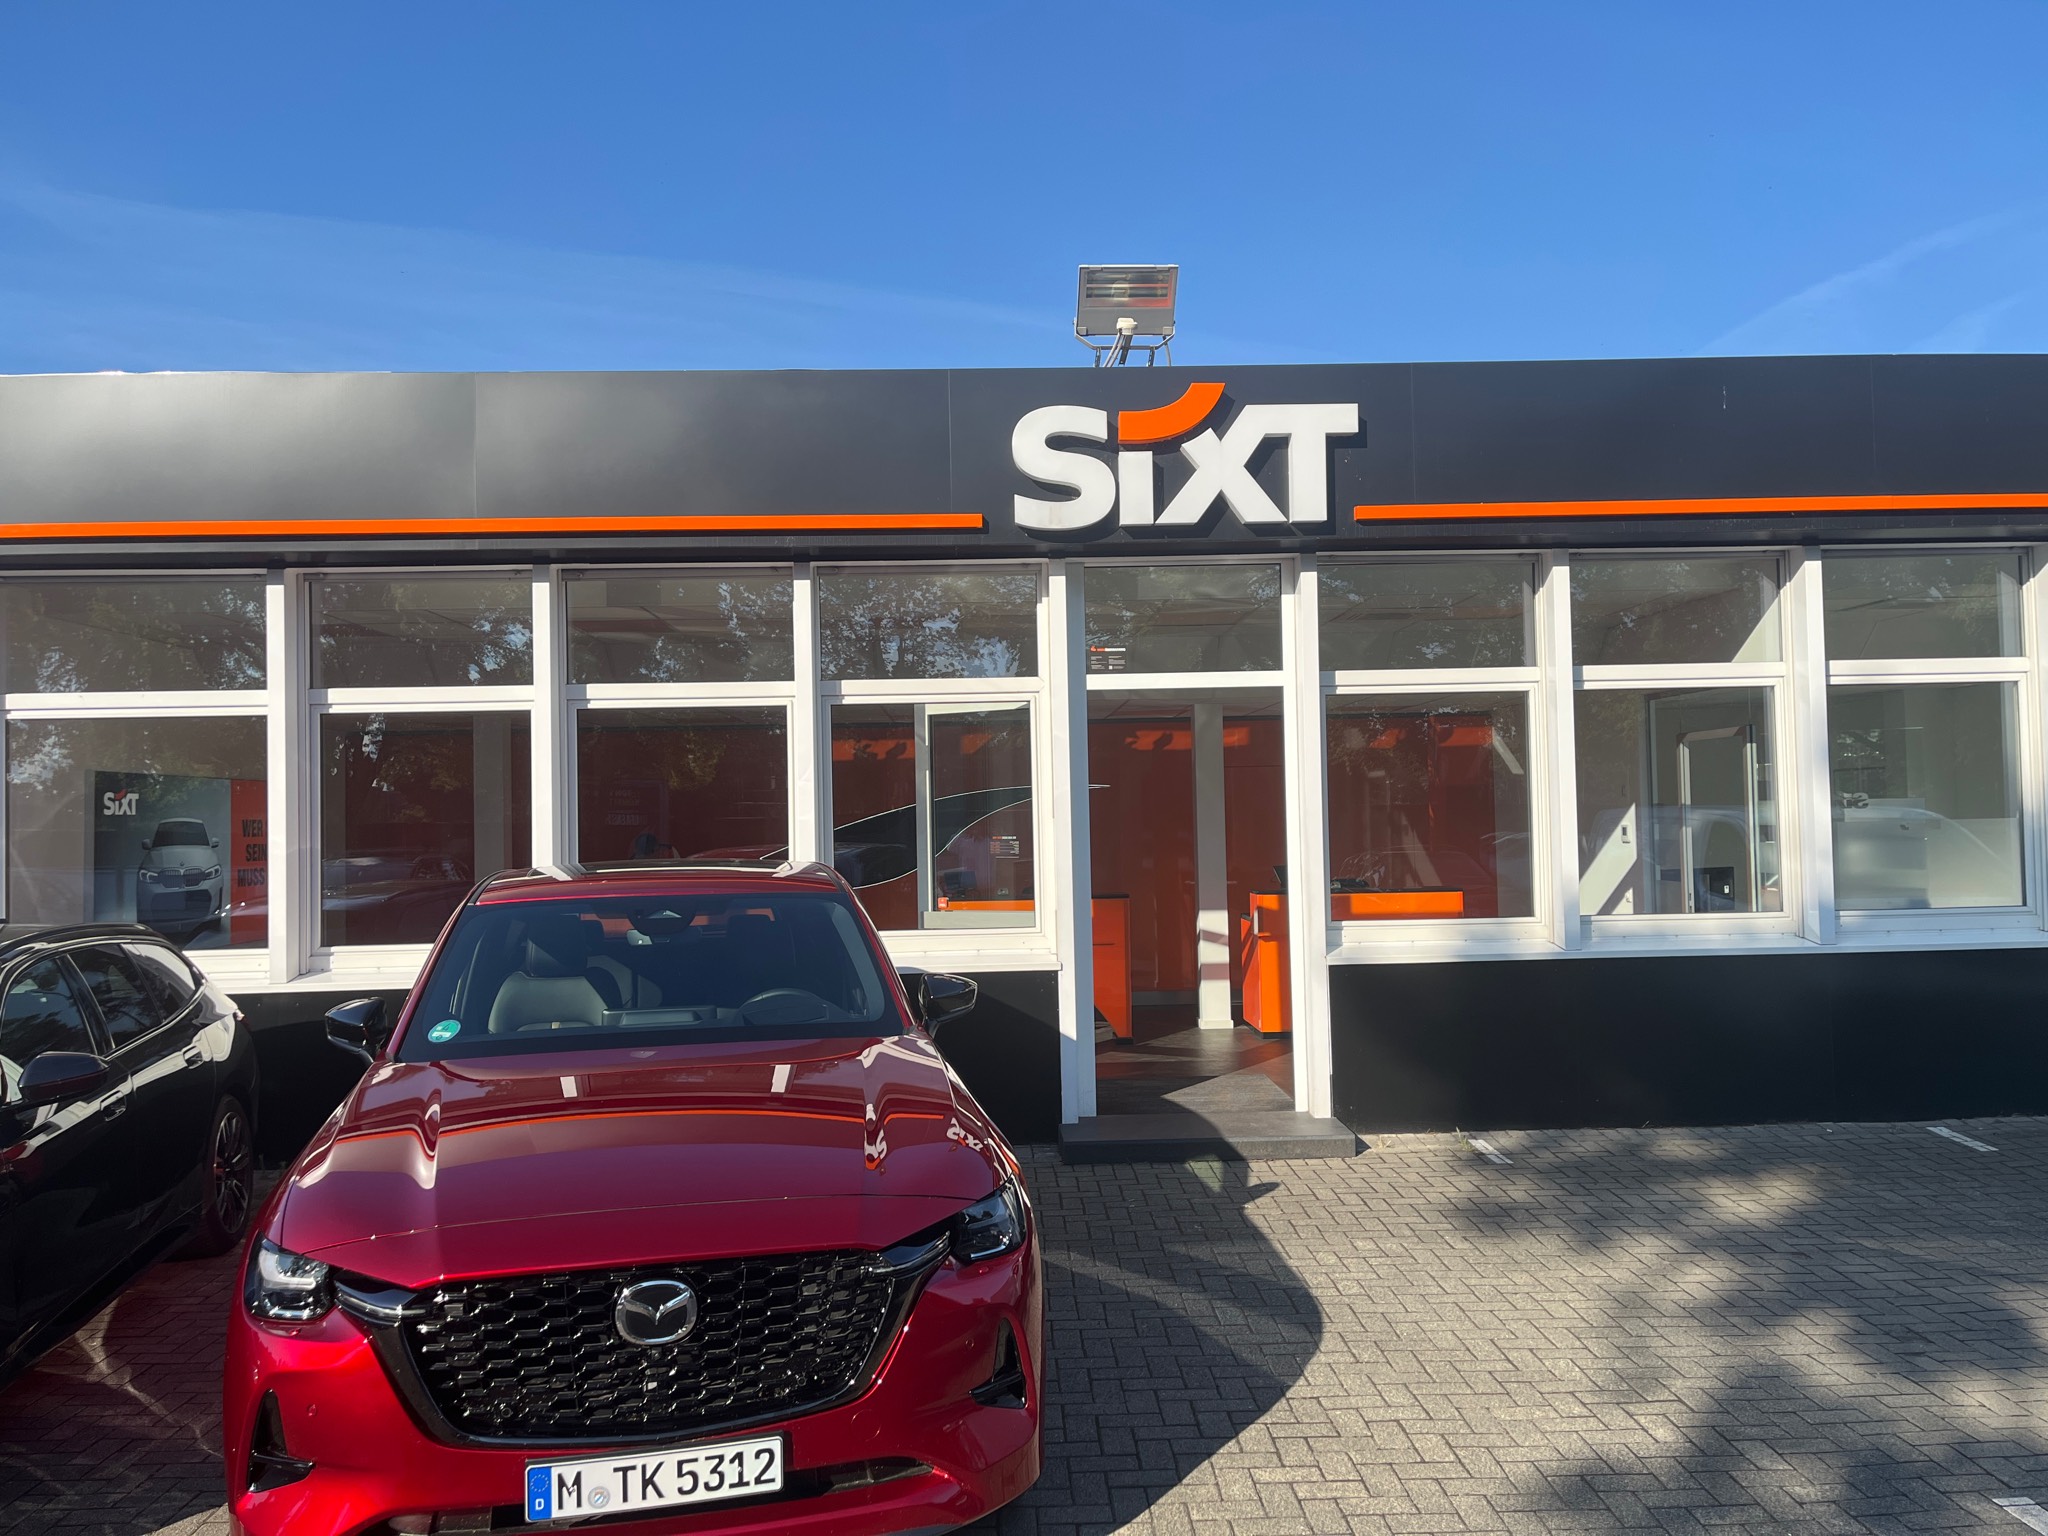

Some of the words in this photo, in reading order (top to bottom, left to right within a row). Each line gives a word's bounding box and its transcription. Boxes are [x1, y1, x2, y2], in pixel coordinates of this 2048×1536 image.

[242, 819, 263, 837] WER
[238, 868, 265, 887] MUSS
[557, 1470, 582, 1510] M
[613, 1461, 665, 1503] TK
[676, 1448, 776, 1496] 5312
[535, 1498, 545, 1511] D
